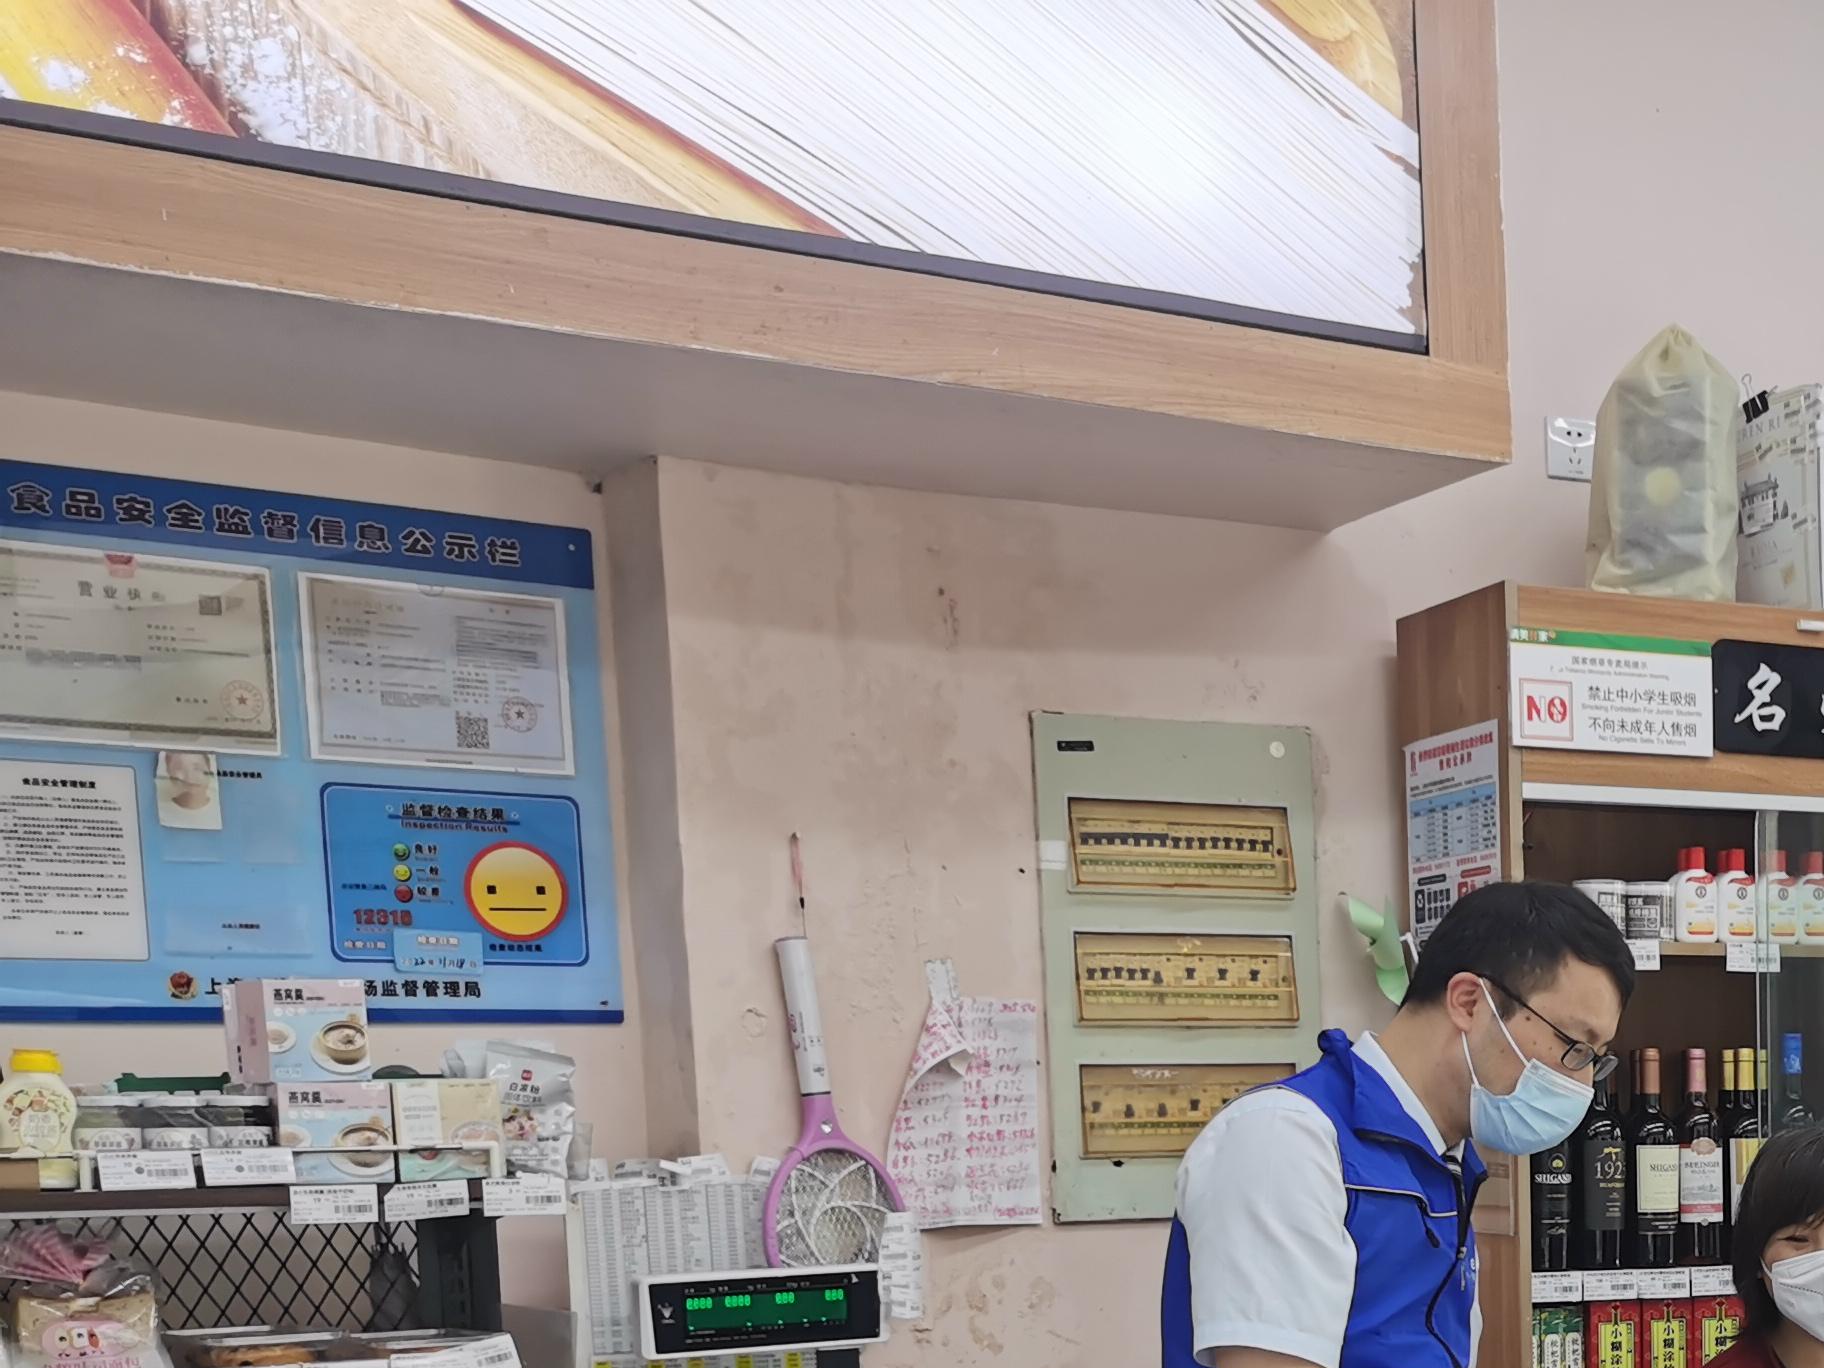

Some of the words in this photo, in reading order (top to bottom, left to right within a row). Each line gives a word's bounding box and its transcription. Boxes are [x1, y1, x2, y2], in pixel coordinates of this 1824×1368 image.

[8, 481, 522, 567] 食品安全监督信息公示栏
[1588, 685, 1697, 707] 禁止中小学生吸烟
[1588, 715, 1697, 738] 不向未成年人售烟
[401, 803, 505, 821] 监督检查结果
